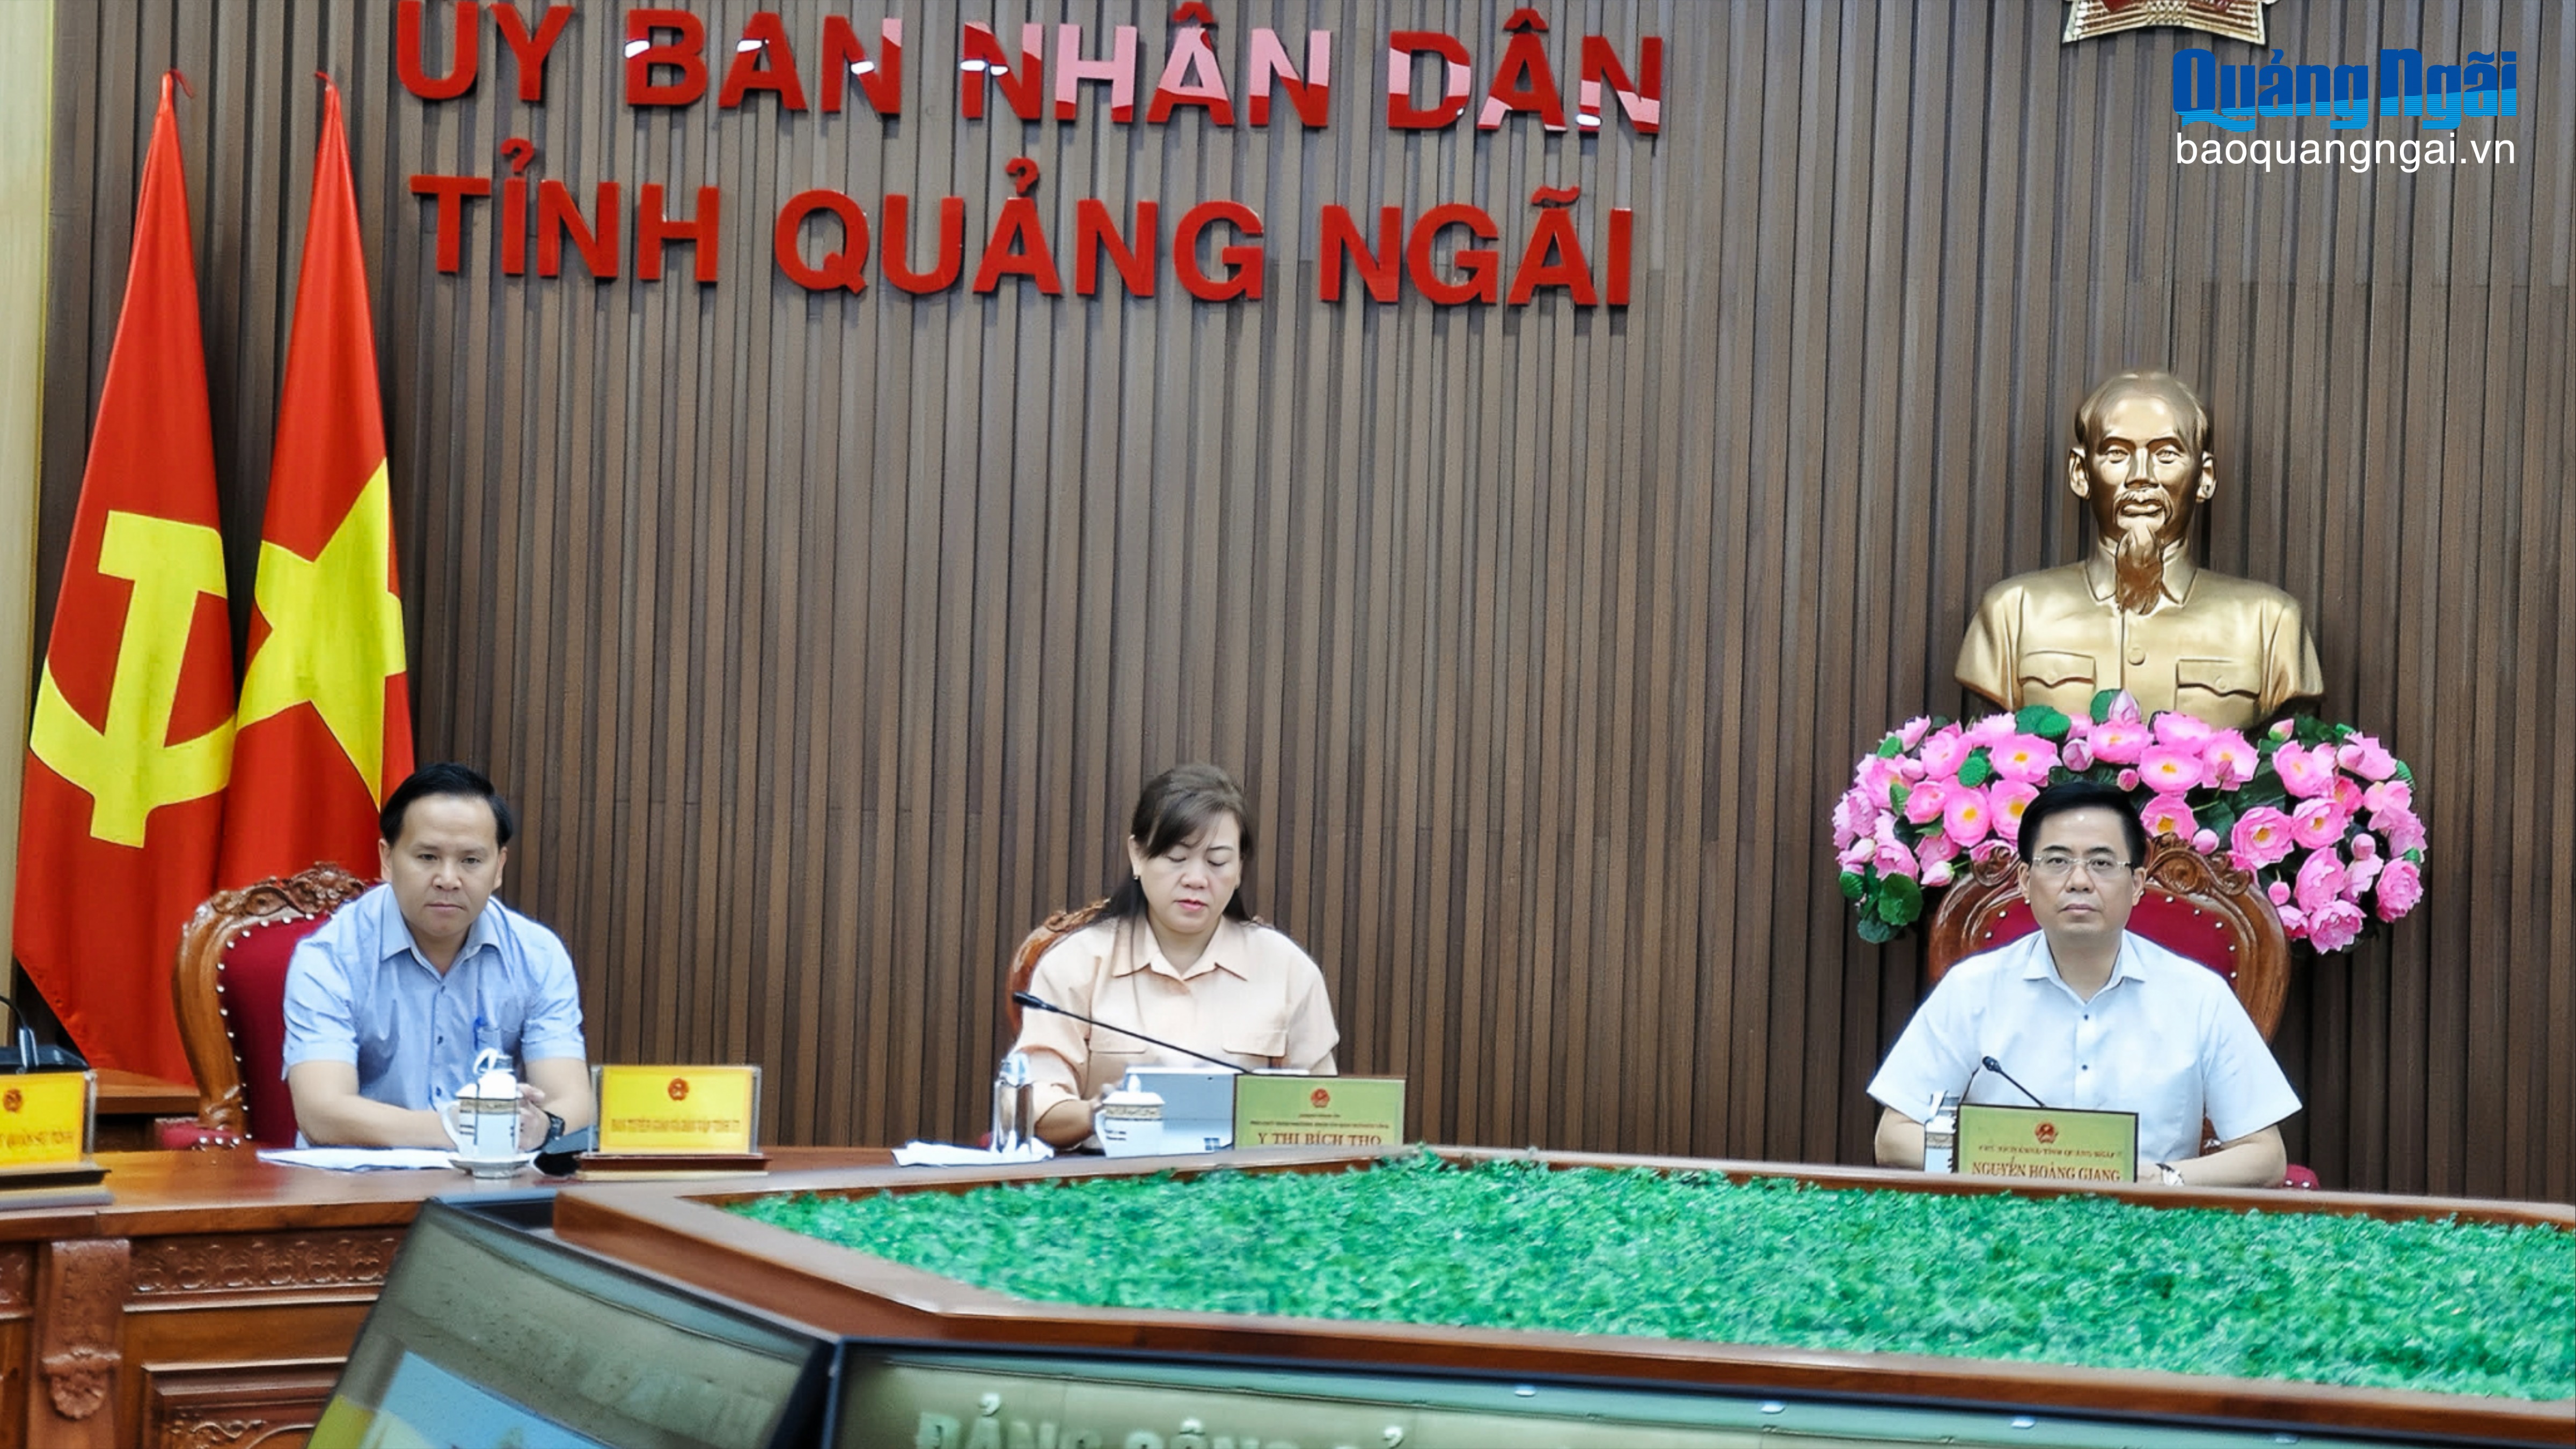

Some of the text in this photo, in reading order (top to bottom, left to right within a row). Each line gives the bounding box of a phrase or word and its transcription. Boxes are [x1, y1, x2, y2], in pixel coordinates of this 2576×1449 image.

[625, 9, 902, 115] BAN
[961, 2, 1331, 127] NHÂN
[1387, 9, 1663, 133] DÂN
[409, 137, 1634, 305] TỈNH QUẢNG NGÃI
